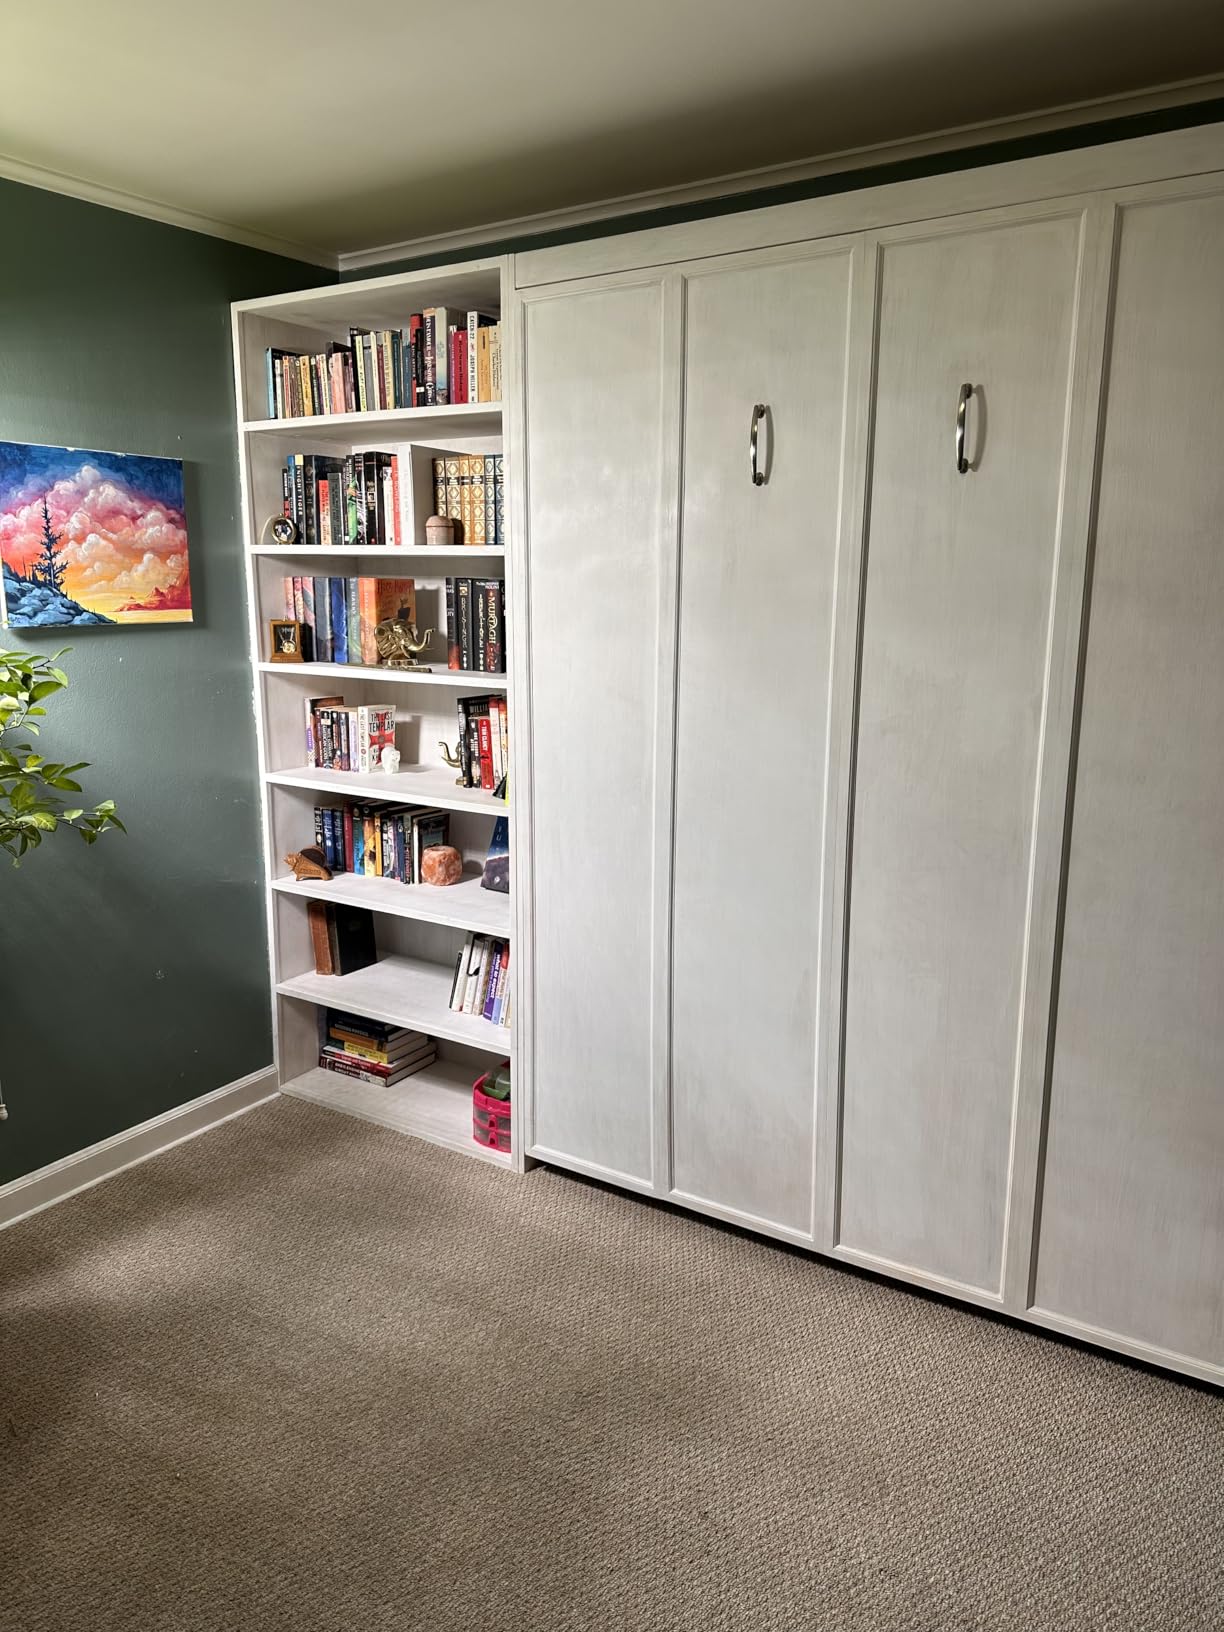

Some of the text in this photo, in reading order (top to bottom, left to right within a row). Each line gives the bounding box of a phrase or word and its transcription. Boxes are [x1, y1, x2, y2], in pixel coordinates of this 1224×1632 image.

[487, 596, 498, 644] MURTAGH
[469, 703, 489, 713] WILLIA
[369, 720, 395, 733] TEMPLAR
[490, 978, 498, 998] expect
